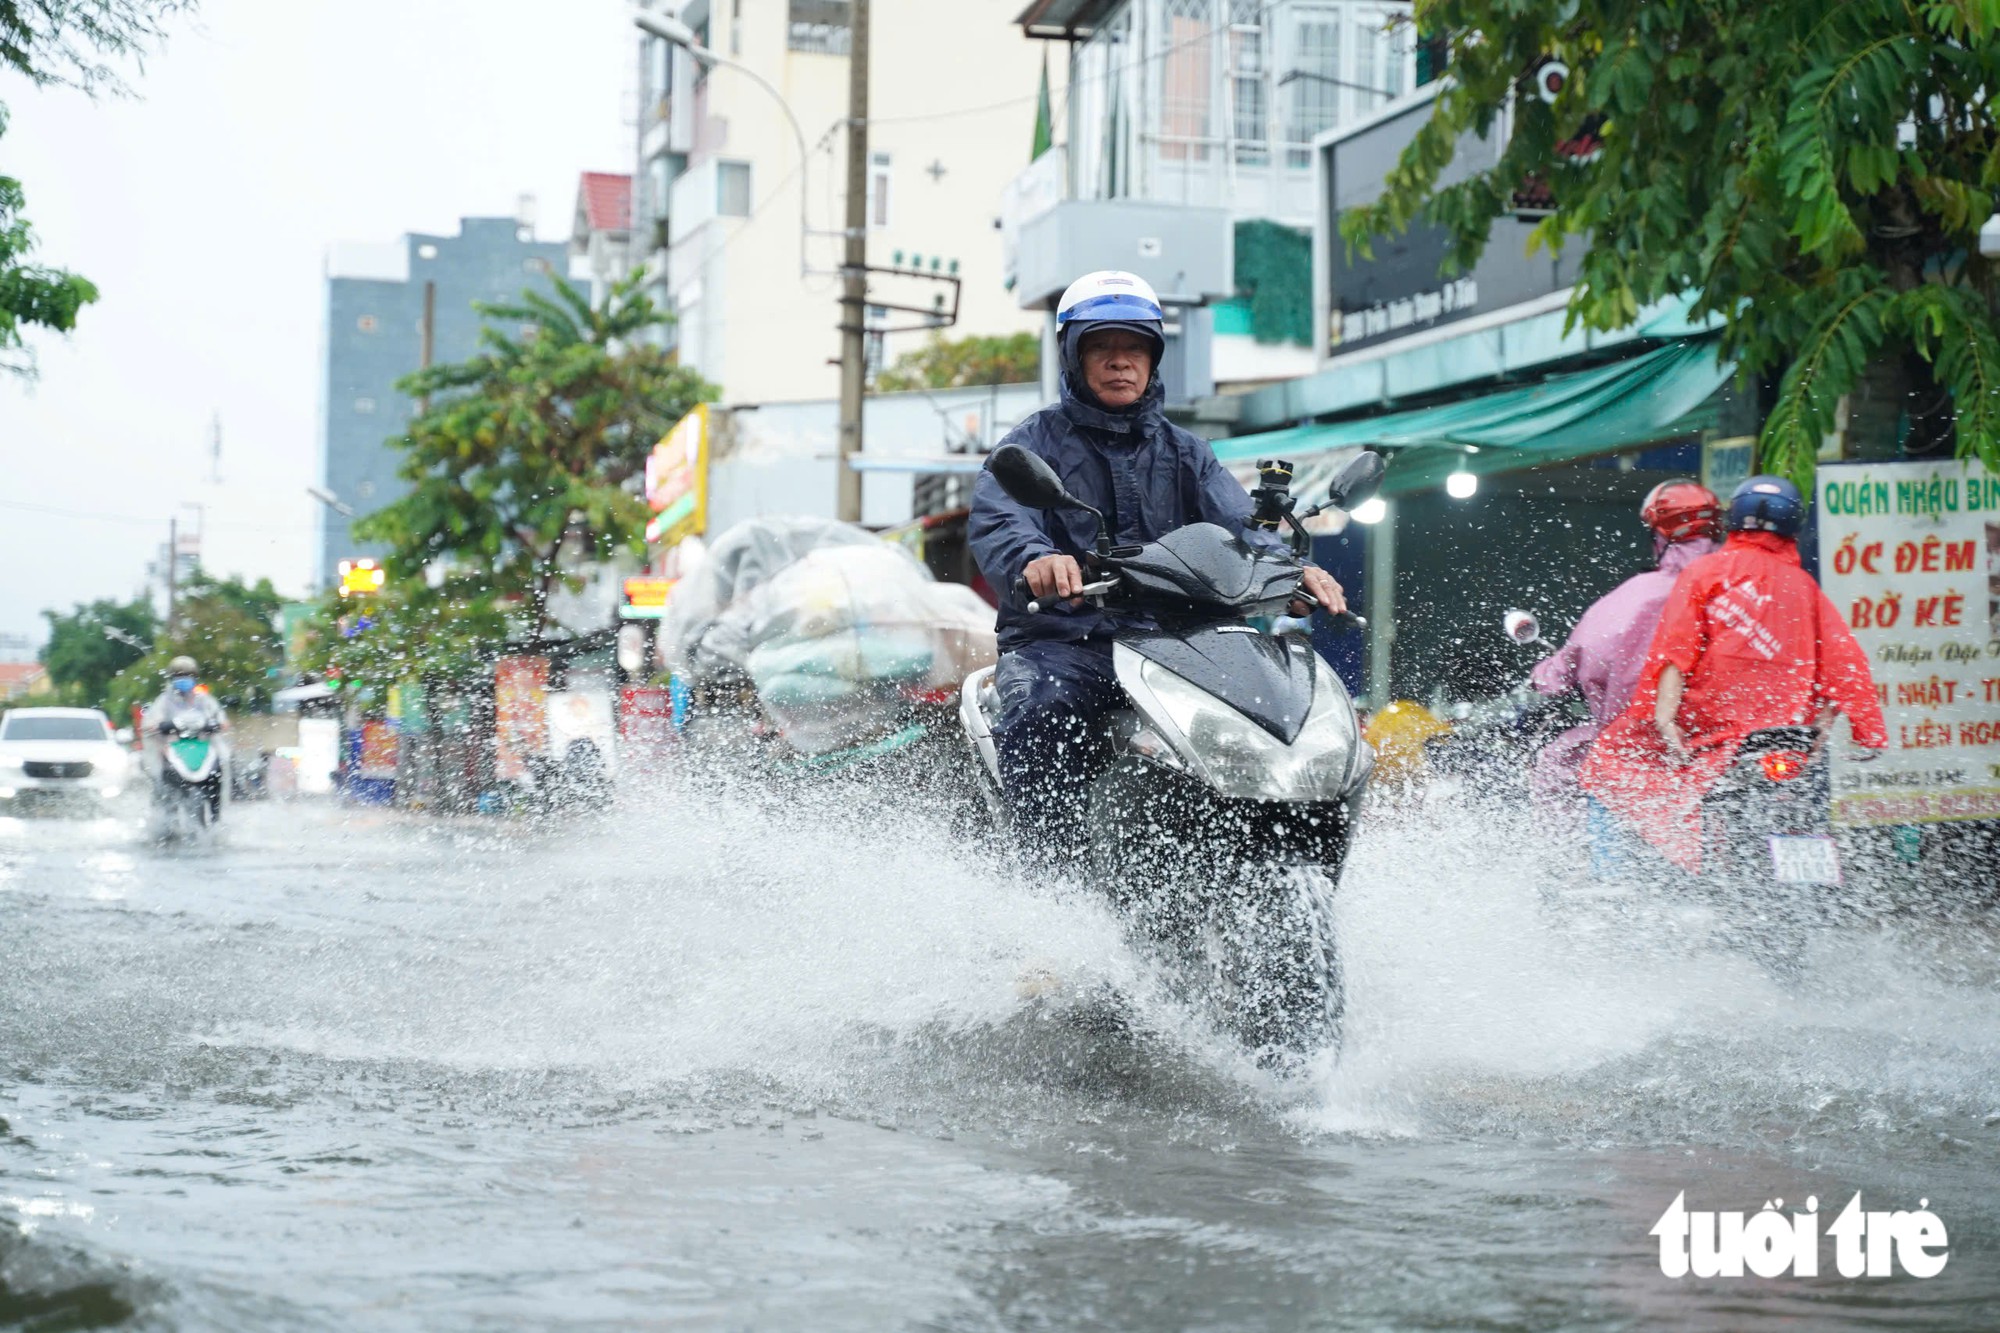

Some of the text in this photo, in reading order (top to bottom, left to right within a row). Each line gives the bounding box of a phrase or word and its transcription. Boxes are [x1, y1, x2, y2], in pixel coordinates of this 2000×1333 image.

[1825, 474, 1890, 517] QUÁN
[1896, 472, 1959, 522] NHẬU
[1834, 532, 1976, 575] ỐC ĐÊM
[1851, 588, 1965, 629] BỜ KÈ
[1898, 674, 1957, 710] NHẬT
